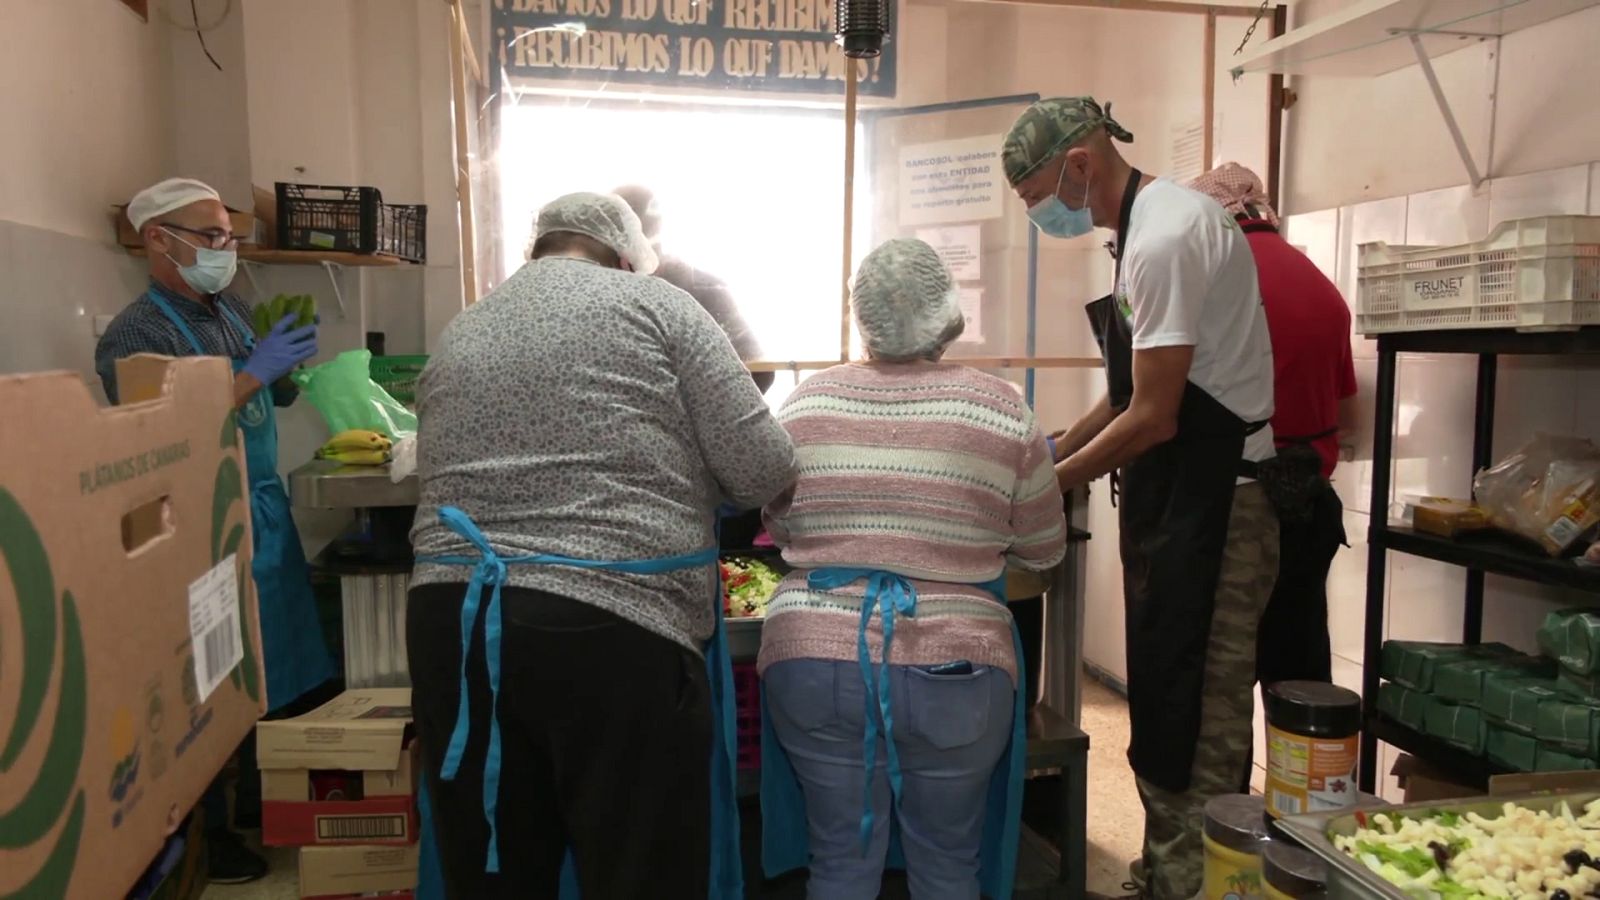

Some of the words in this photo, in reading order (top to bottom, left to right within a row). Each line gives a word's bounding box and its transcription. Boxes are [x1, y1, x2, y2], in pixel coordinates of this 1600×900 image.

[678, 35, 714, 77] LO
[949, 165, 991, 176] ENTIDAD
[1414, 276, 1464, 293] FRUNET
